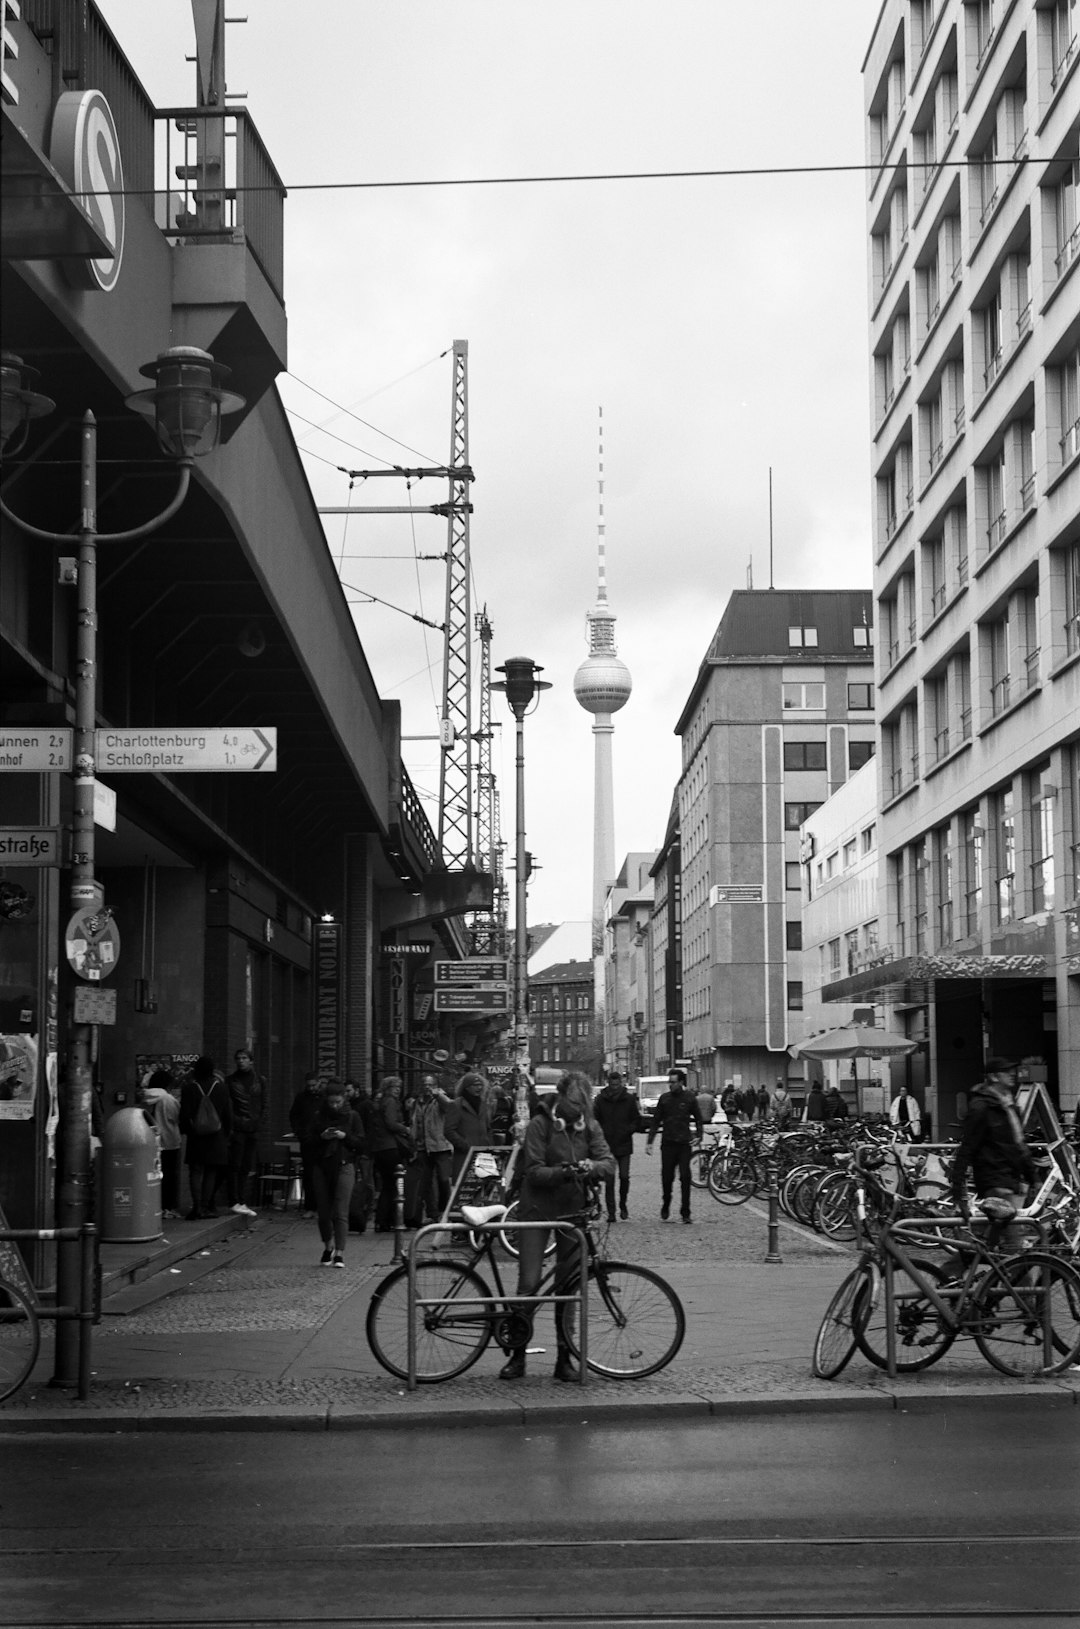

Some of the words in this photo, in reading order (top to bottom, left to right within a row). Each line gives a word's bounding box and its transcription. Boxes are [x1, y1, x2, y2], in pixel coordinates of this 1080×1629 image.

[106, 734, 206, 750] Charlottenburg
[106, 753, 184, 768] Schloßplatz
[319, 930, 337, 980] NOLLE
[318, 985, 337, 1078] ESTAURANT
[171, 1054, 200, 1062] TANGO
